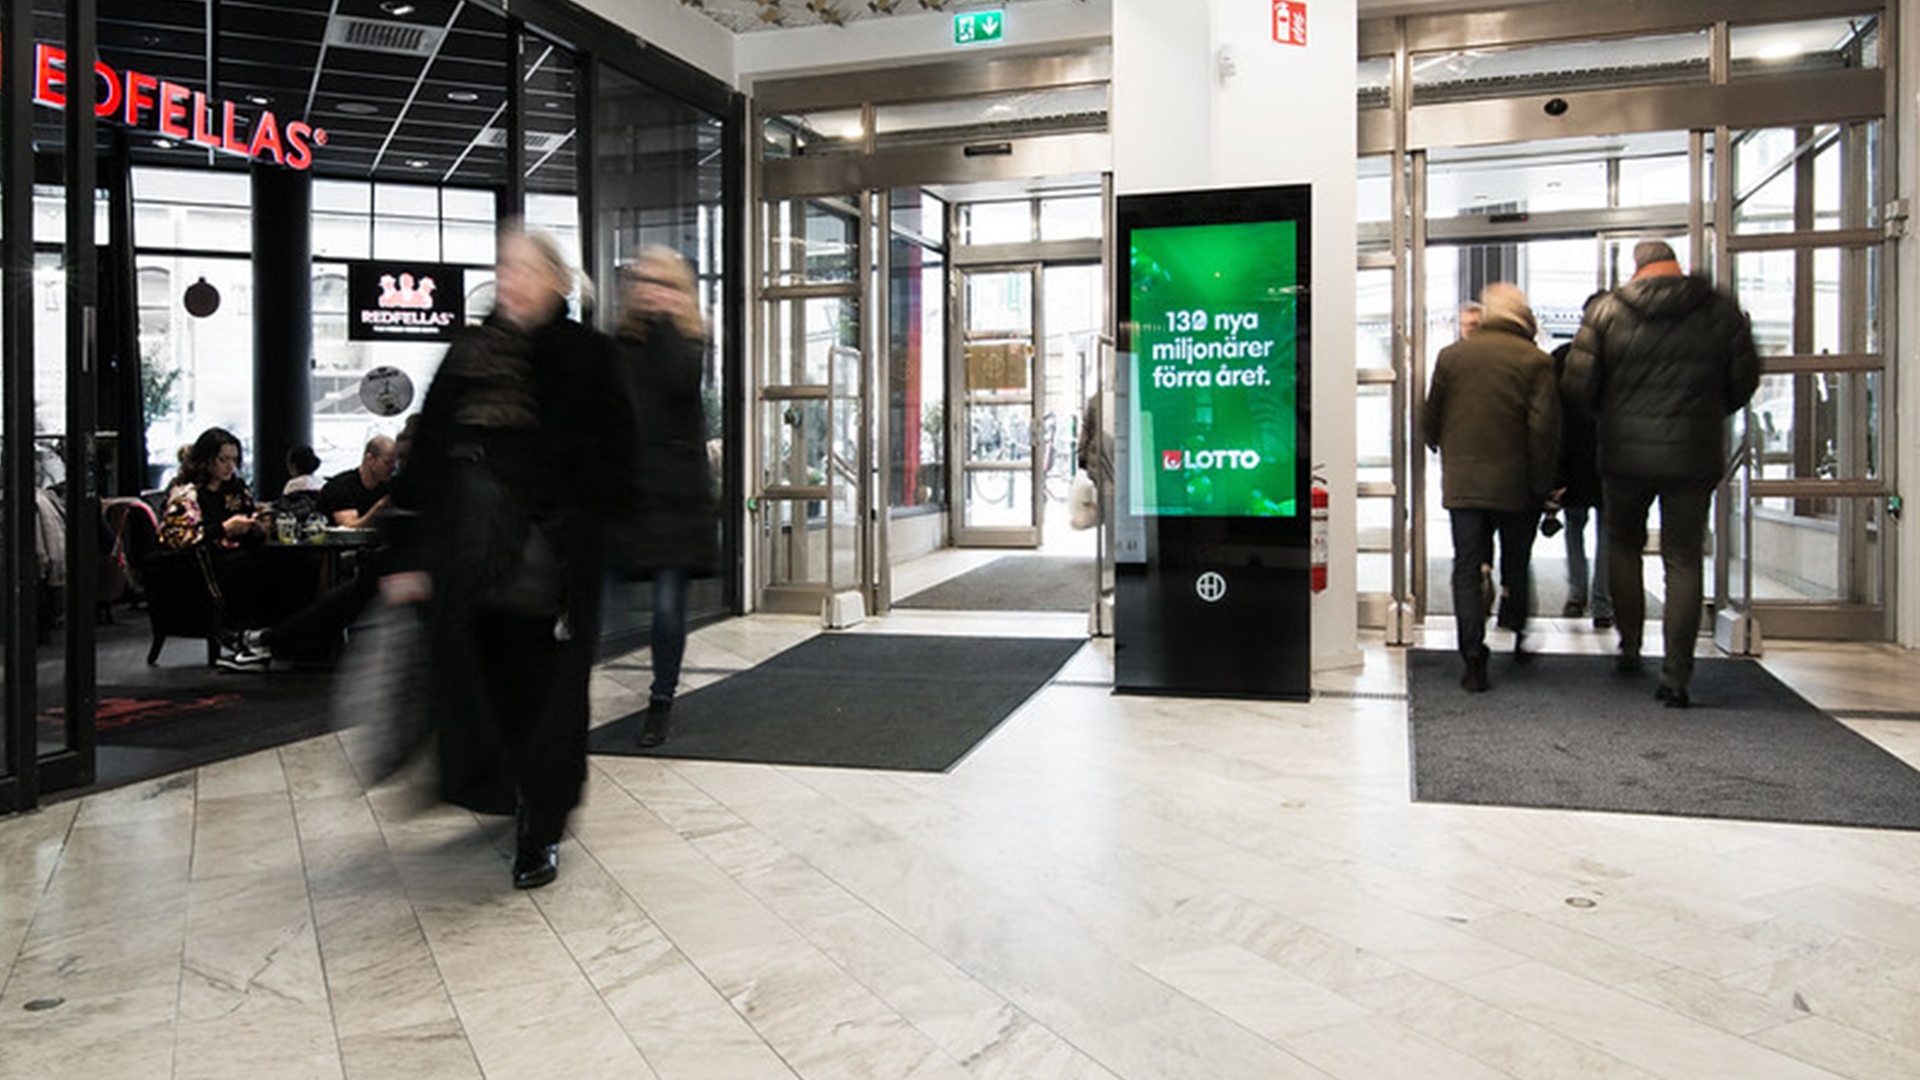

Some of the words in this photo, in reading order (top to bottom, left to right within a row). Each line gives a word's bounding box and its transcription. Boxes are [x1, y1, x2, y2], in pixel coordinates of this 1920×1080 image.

[1214, 312, 1259, 335] nya
[1152, 335, 1274, 365] miljonärer
[1152, 365, 1212, 388] förra
[1215, 363, 1271, 387] året.
[1184, 449, 1261, 469] LOTTO
